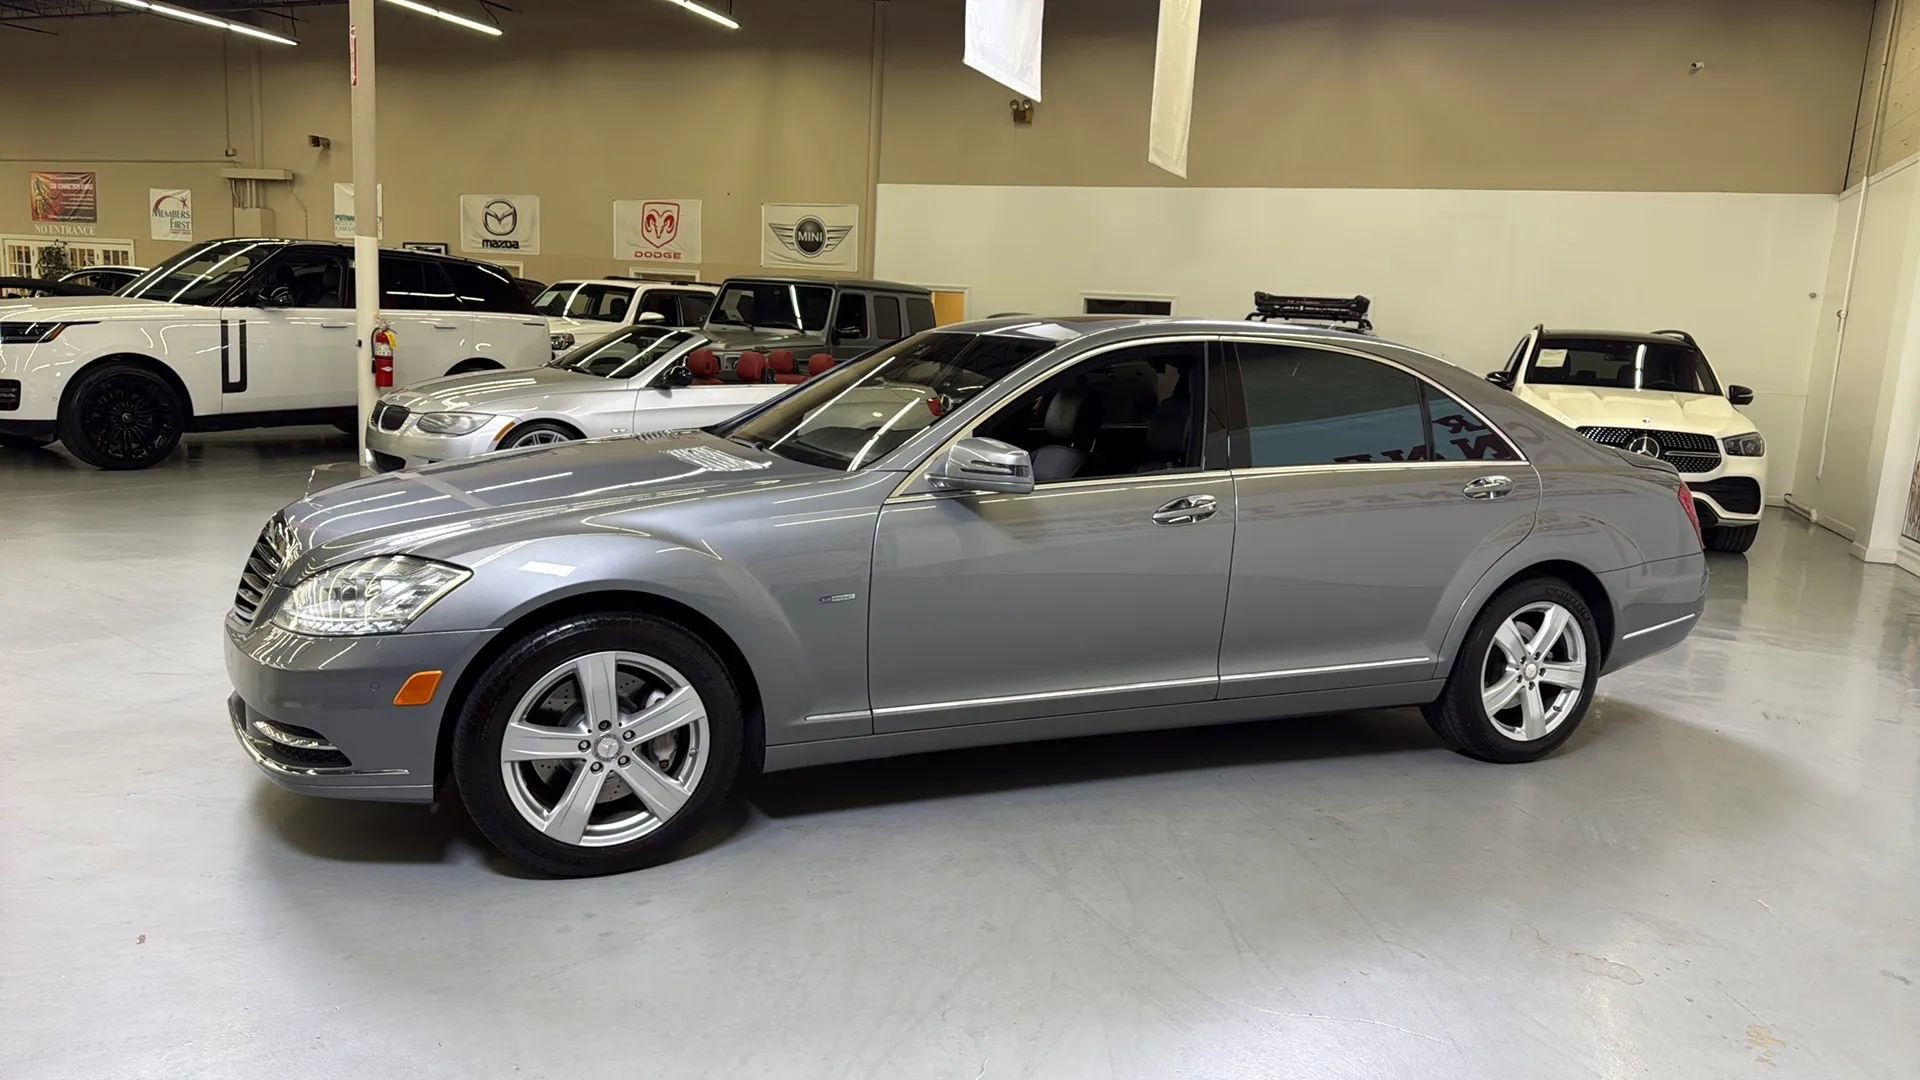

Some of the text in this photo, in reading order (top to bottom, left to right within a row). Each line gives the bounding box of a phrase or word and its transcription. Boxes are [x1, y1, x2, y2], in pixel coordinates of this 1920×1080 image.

[152, 208, 191, 219] MEMBERS
[170, 218, 191, 229] FIRST
[34, 223, 96, 236] NO ENTRANCE
[797, 231, 823, 242] MINI
[634, 250, 682, 260] DODGE
